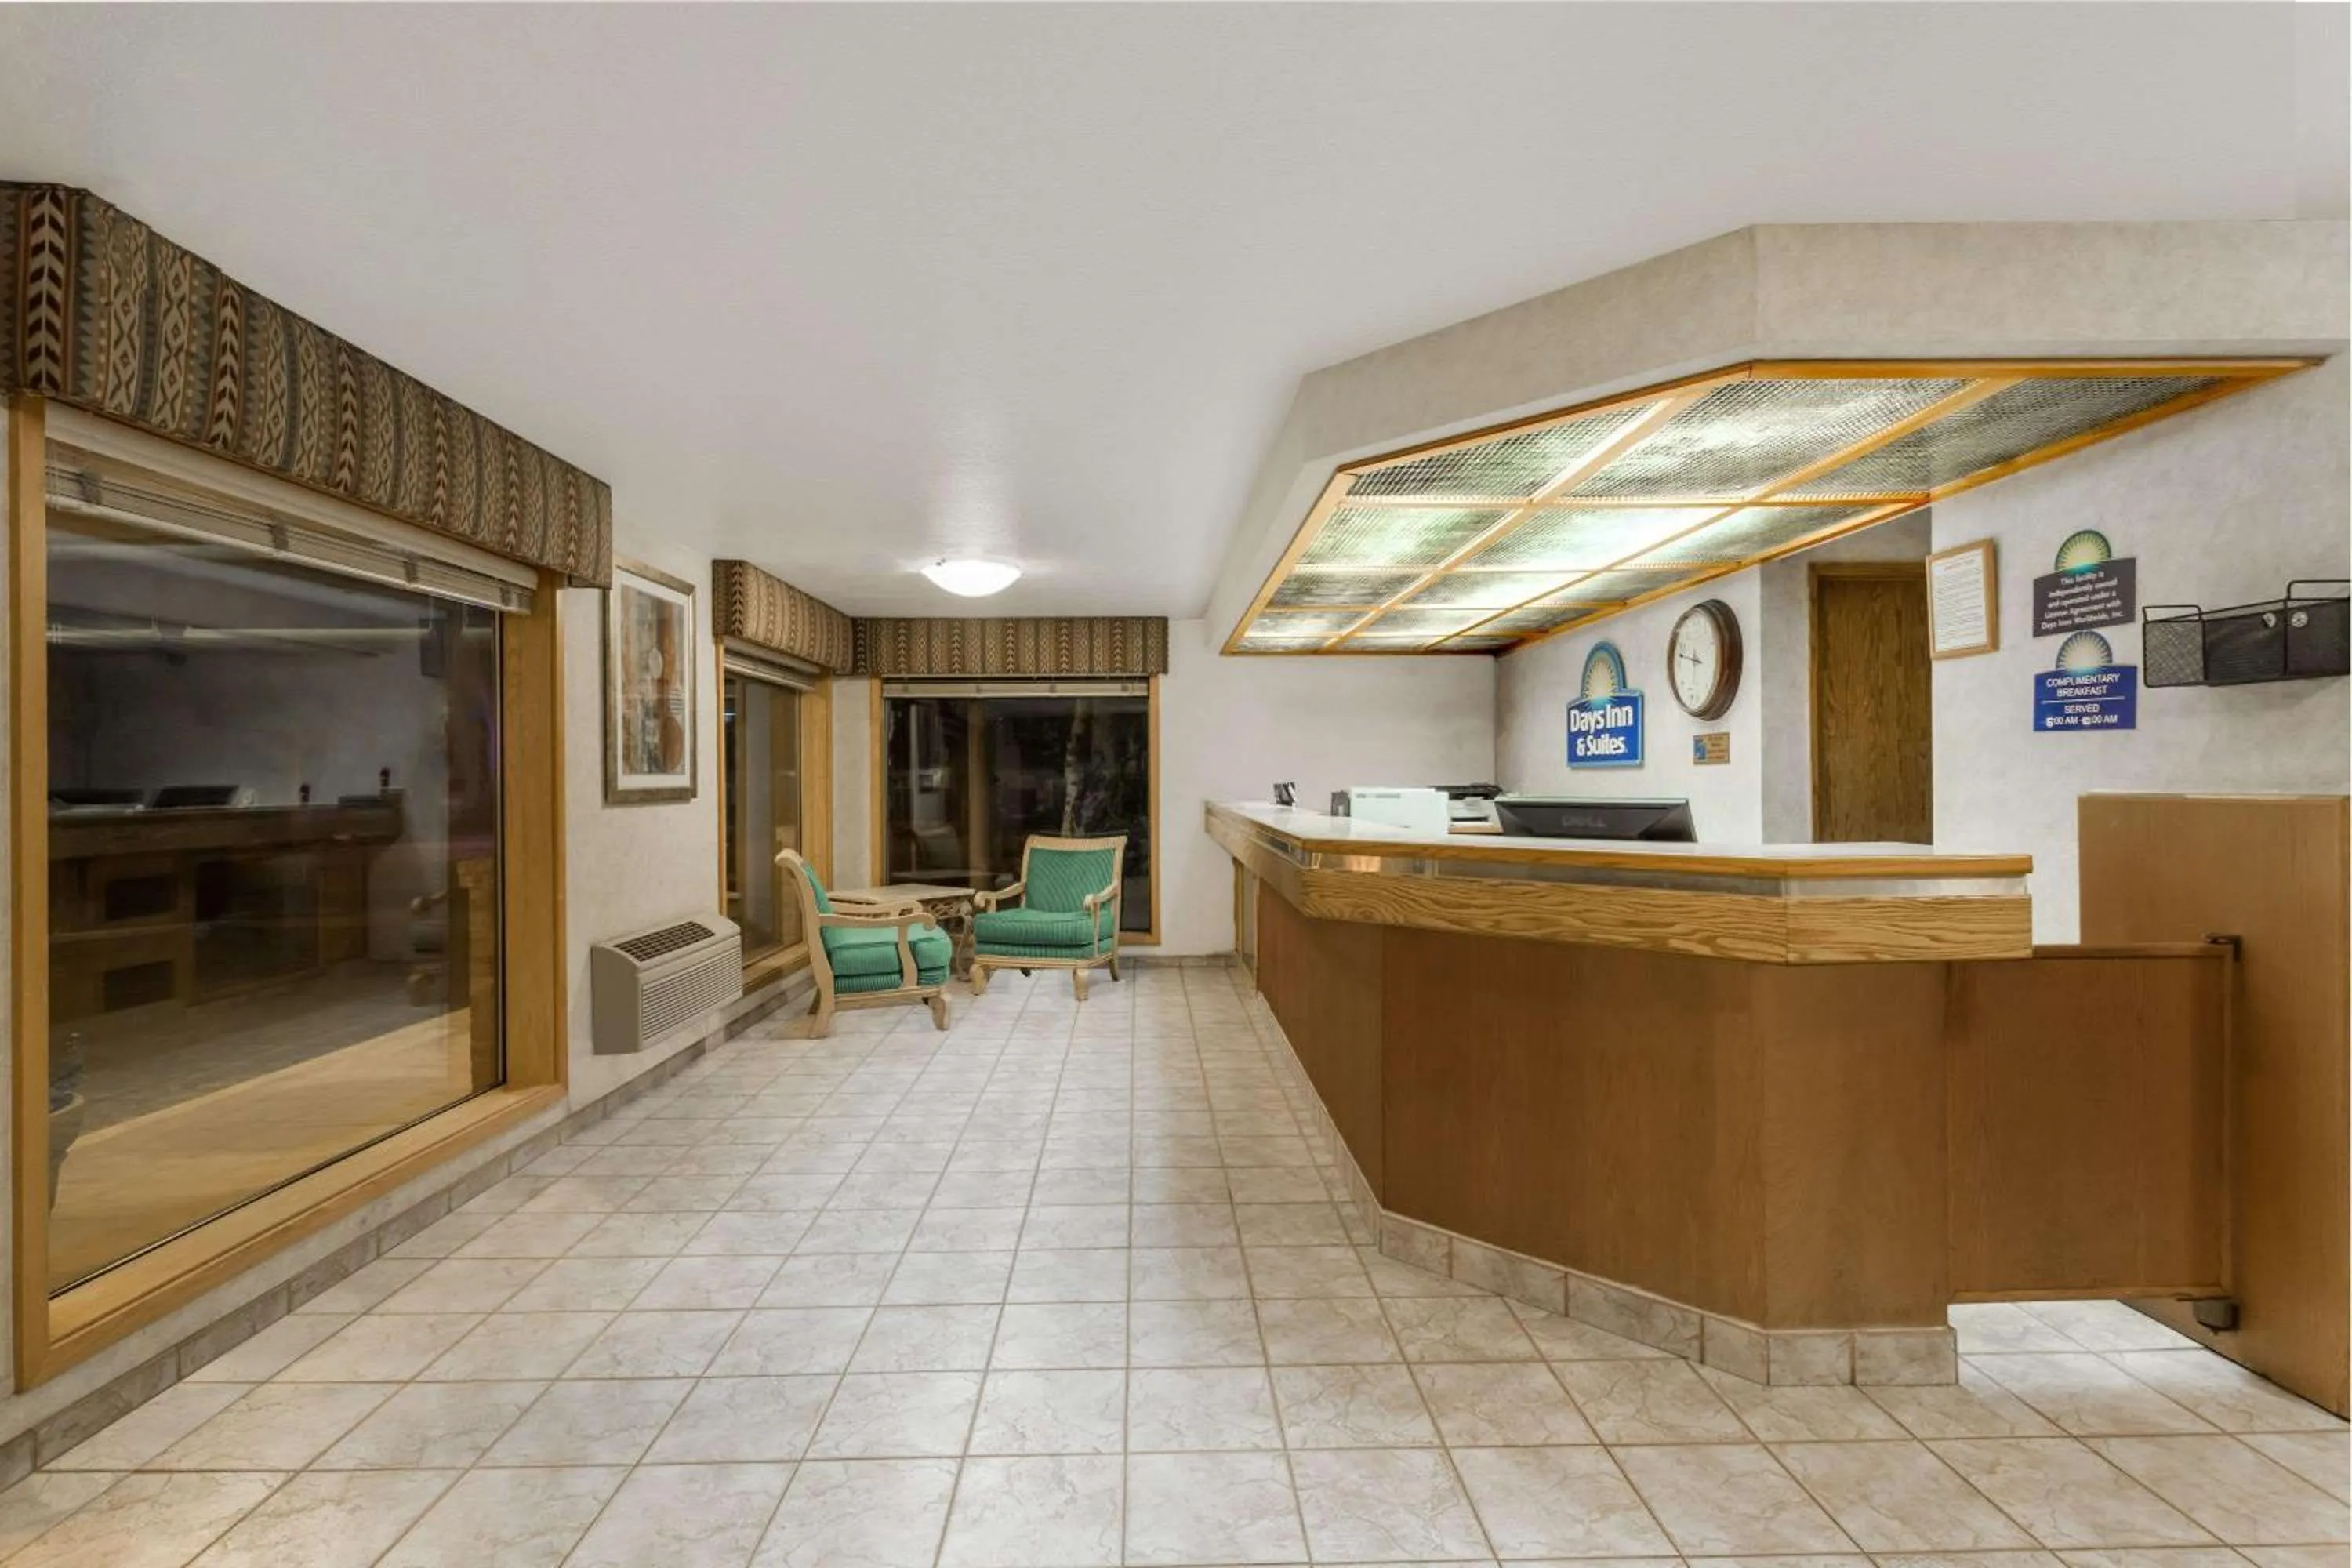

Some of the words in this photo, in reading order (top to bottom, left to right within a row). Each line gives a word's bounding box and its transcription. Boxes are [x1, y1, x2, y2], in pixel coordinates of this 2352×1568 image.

[2045, 673, 2120, 688] COMPLIMENTARY
[2056, 684, 2107, 697] BREAKFAST
[2063, 703, 2100, 714] SERVED
[1570, 709, 1605, 735] Days
[1606, 704, 1633, 728] Inn
[2065, 715, 2078, 725] AM
[2103, 714, 2118, 723] AM
[1577, 737, 1585, 757] &
[1586, 733, 1625, 757] Suites
